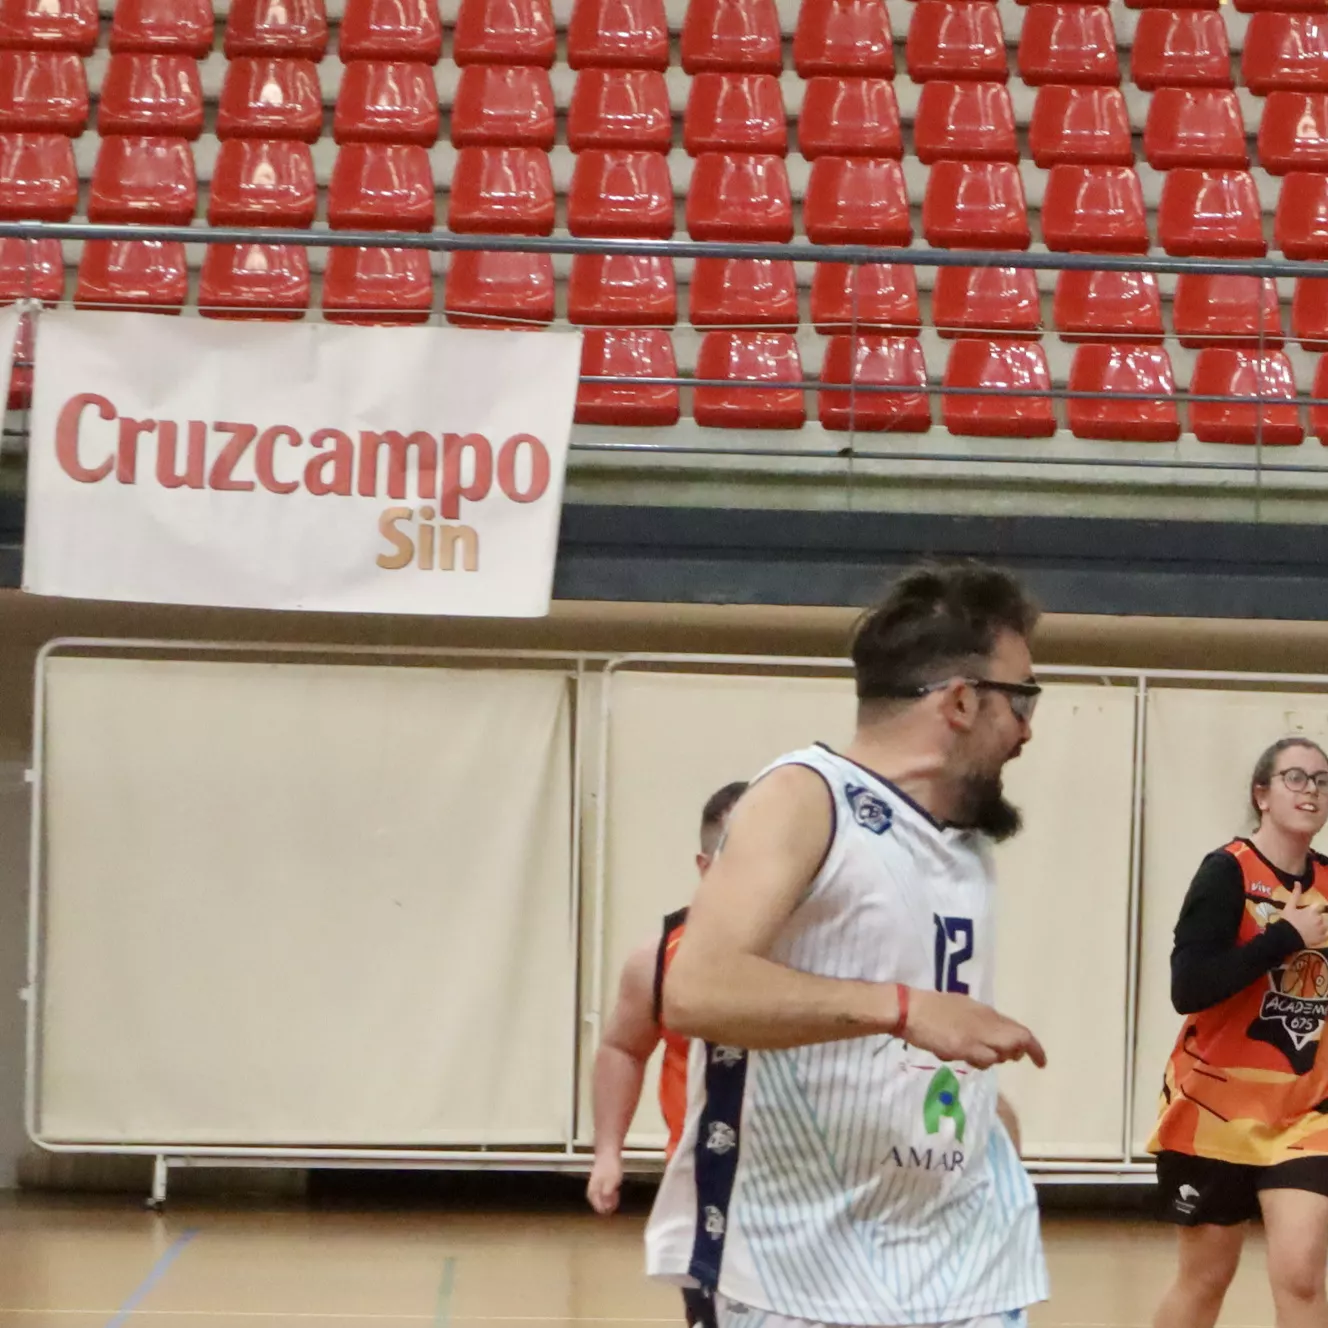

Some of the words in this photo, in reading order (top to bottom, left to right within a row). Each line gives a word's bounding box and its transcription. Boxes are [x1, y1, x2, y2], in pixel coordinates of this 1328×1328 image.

[55, 392, 552, 520] Cruzcampo
[376, 506, 480, 572] Sin
[934, 912, 974, 994] 12
[1265, 997, 1328, 1016] ACADEM
[1291, 1017, 1314, 1031] 675
